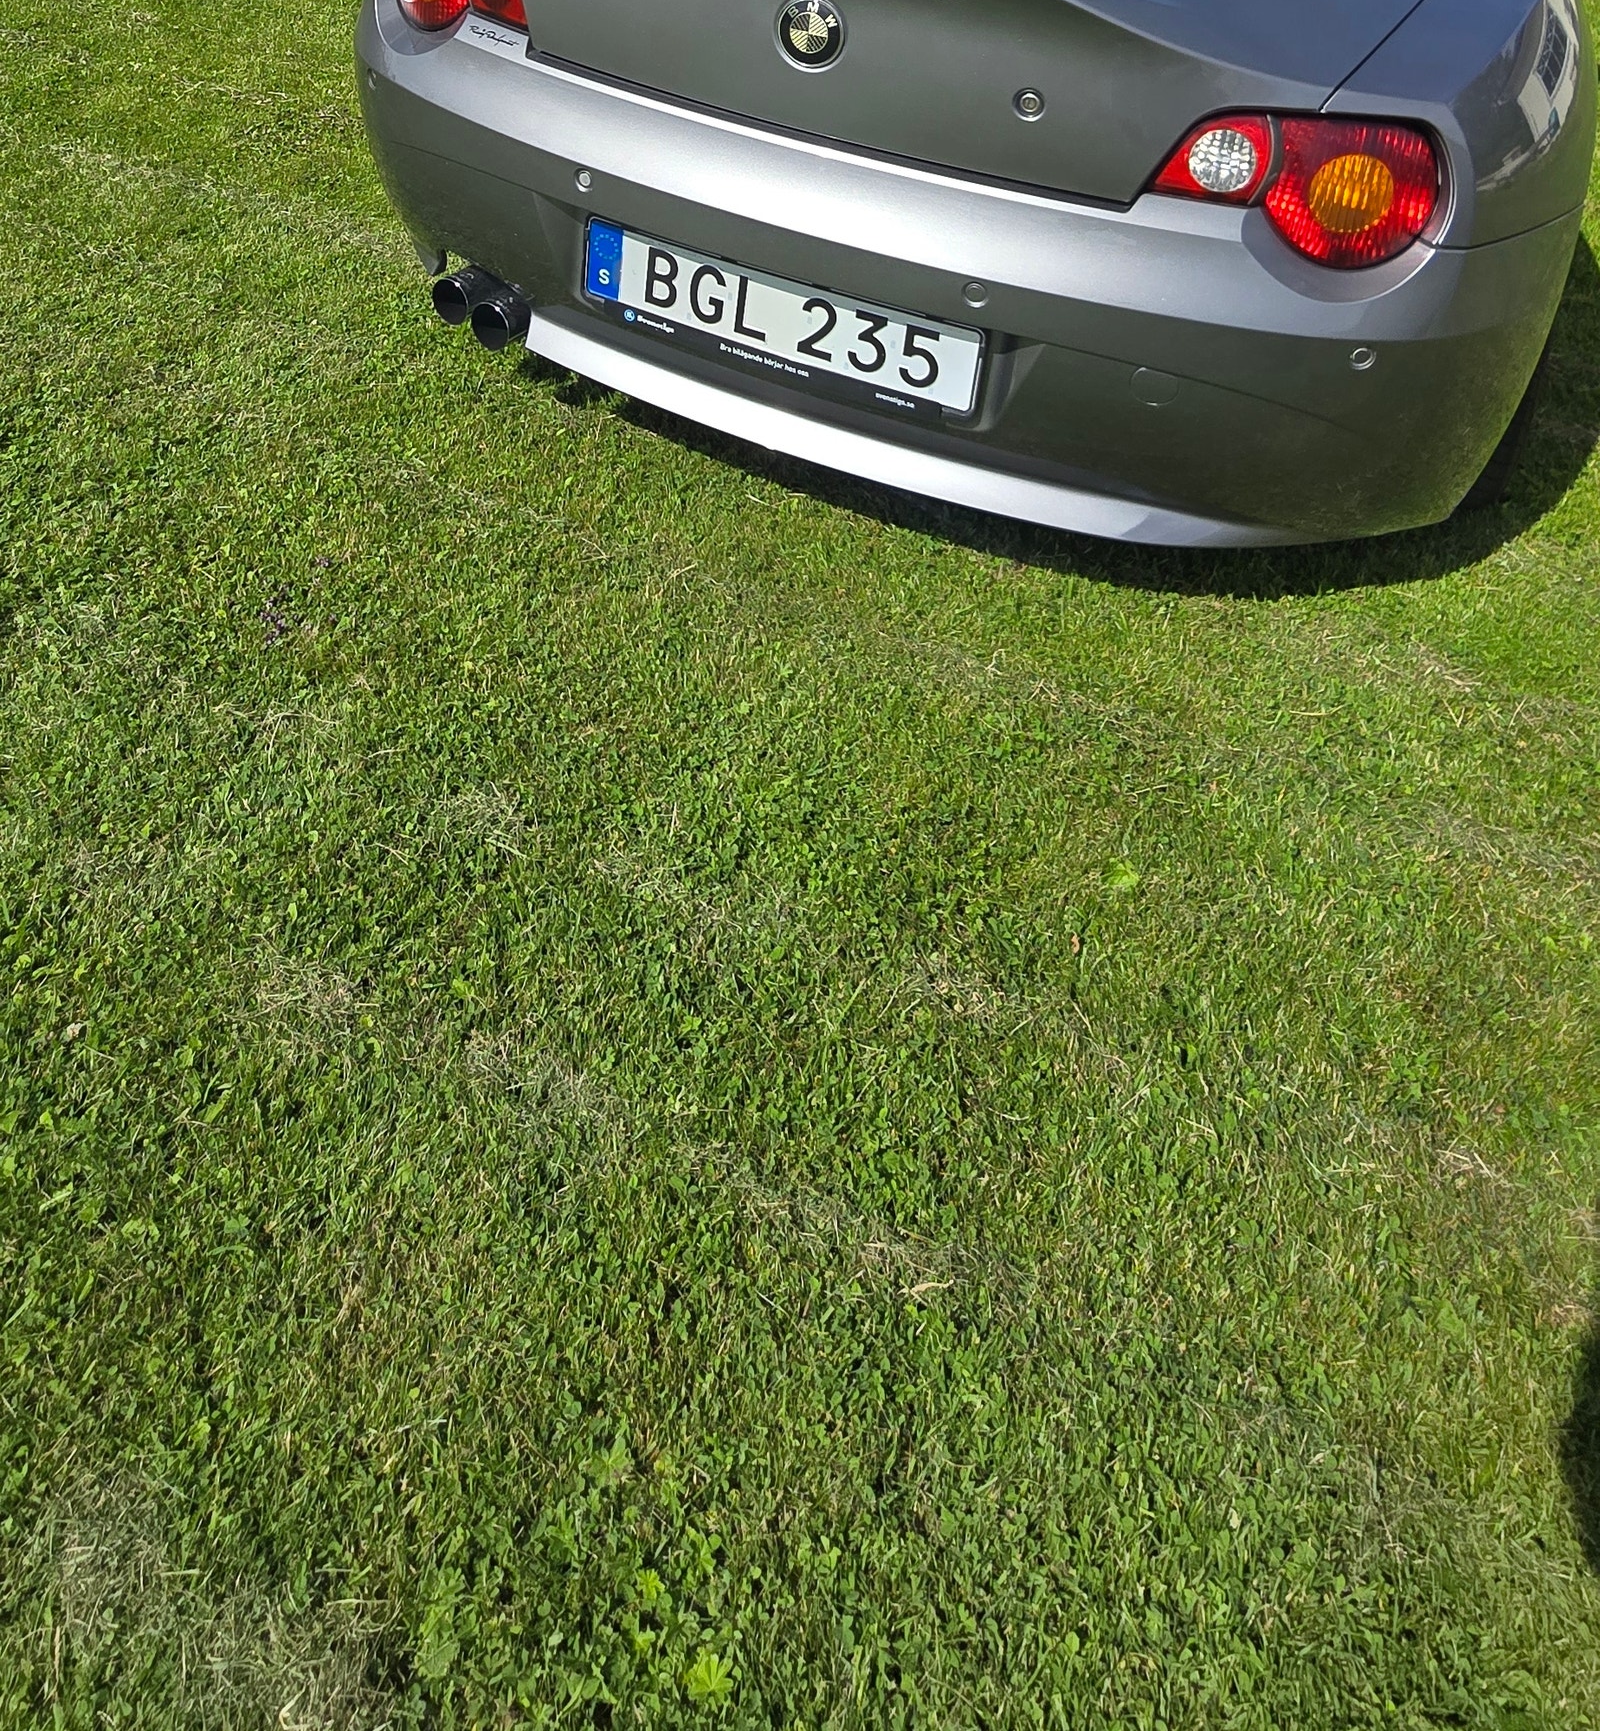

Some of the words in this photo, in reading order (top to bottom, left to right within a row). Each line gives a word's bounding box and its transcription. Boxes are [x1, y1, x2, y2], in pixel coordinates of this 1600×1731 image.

[787, 1, 838, 28] BMW
[599, 268, 610, 285] S
[645, 246, 767, 342] BGL
[797, 297, 941, 388] 235
